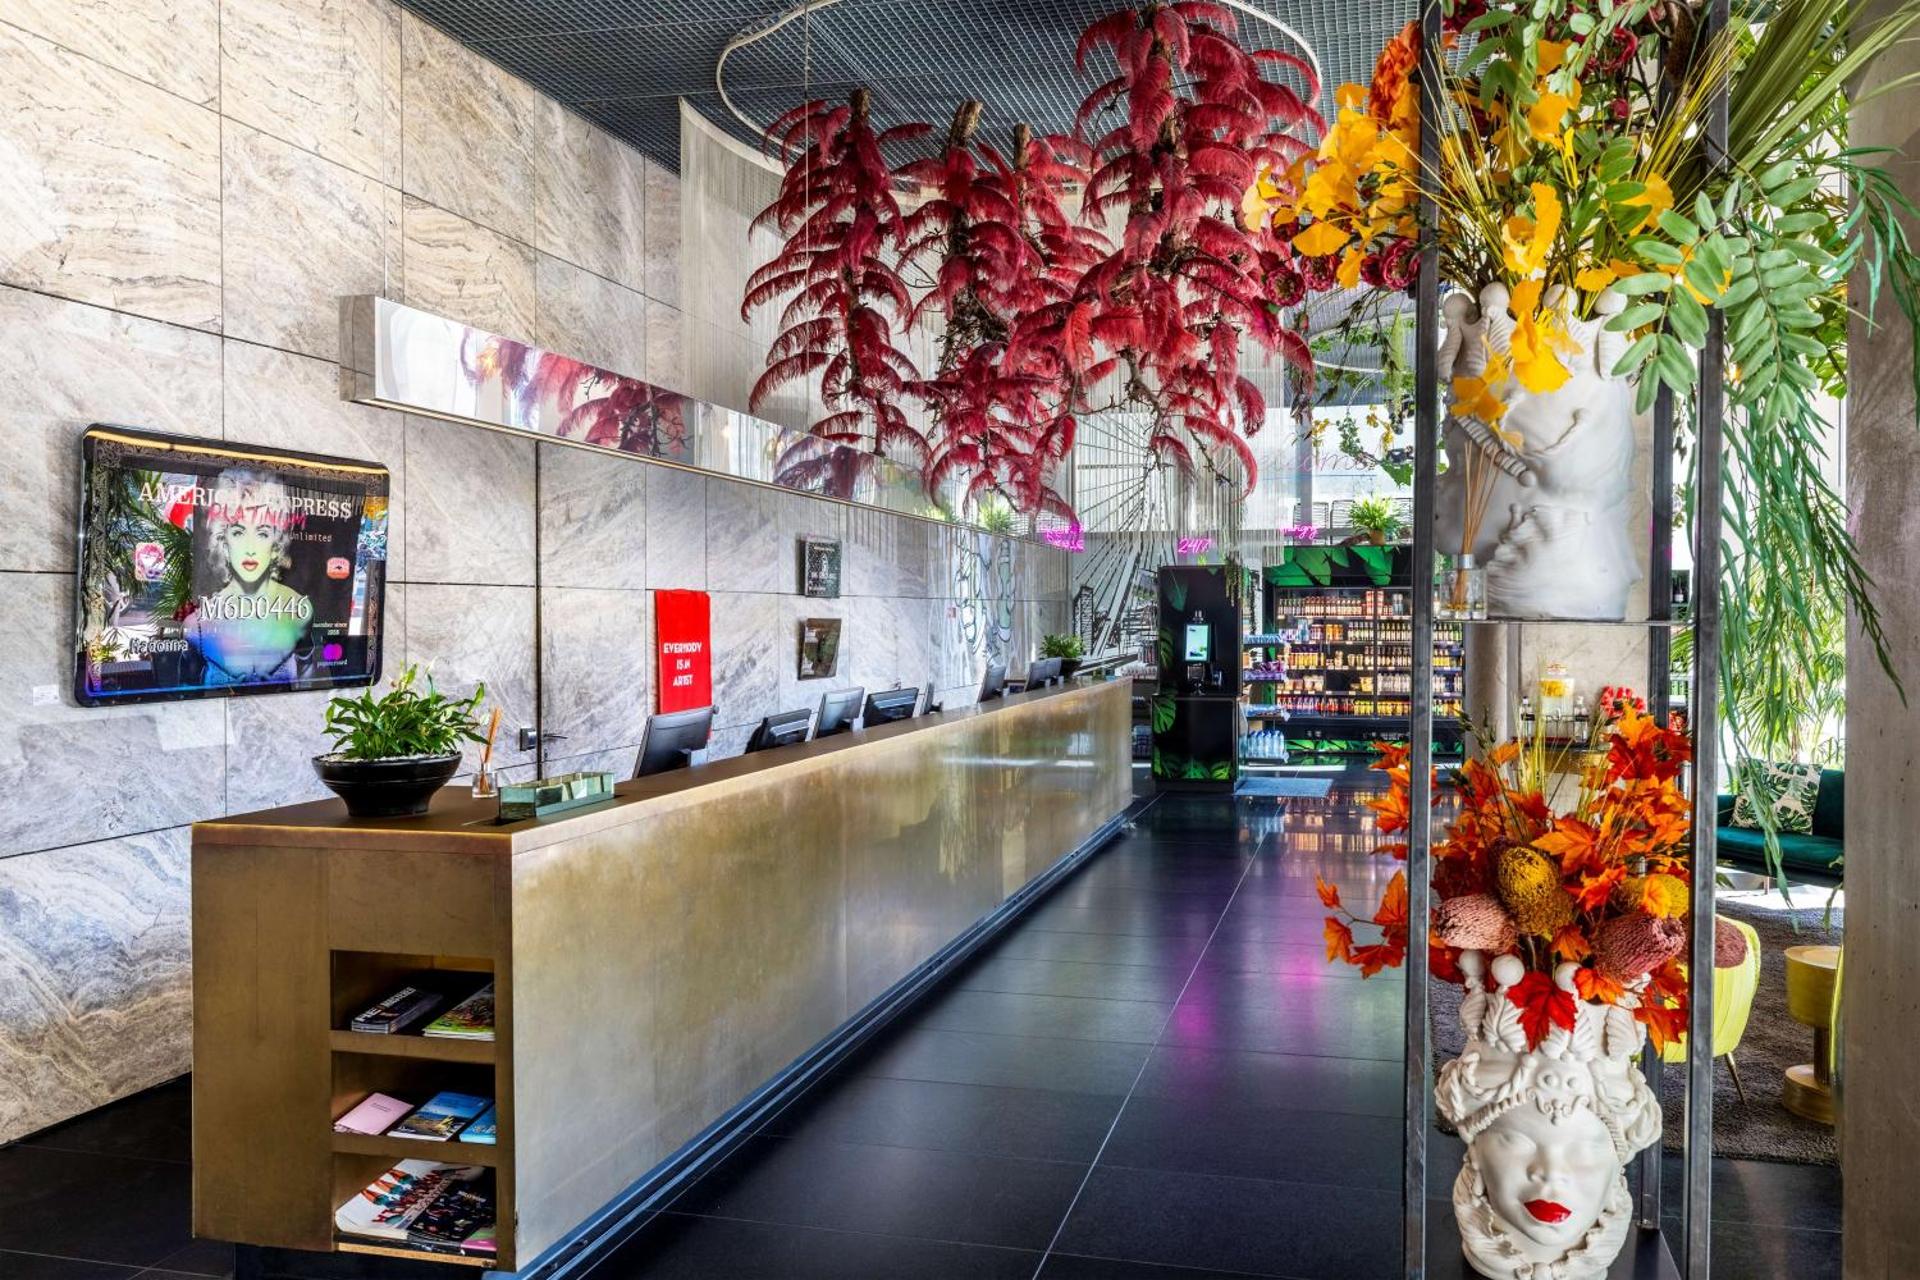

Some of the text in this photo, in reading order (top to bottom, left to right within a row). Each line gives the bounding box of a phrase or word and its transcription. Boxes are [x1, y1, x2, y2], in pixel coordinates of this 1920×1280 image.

[138, 482, 352, 521] AMERICN PRE$$
[199, 594, 311, 621] M6D0446
